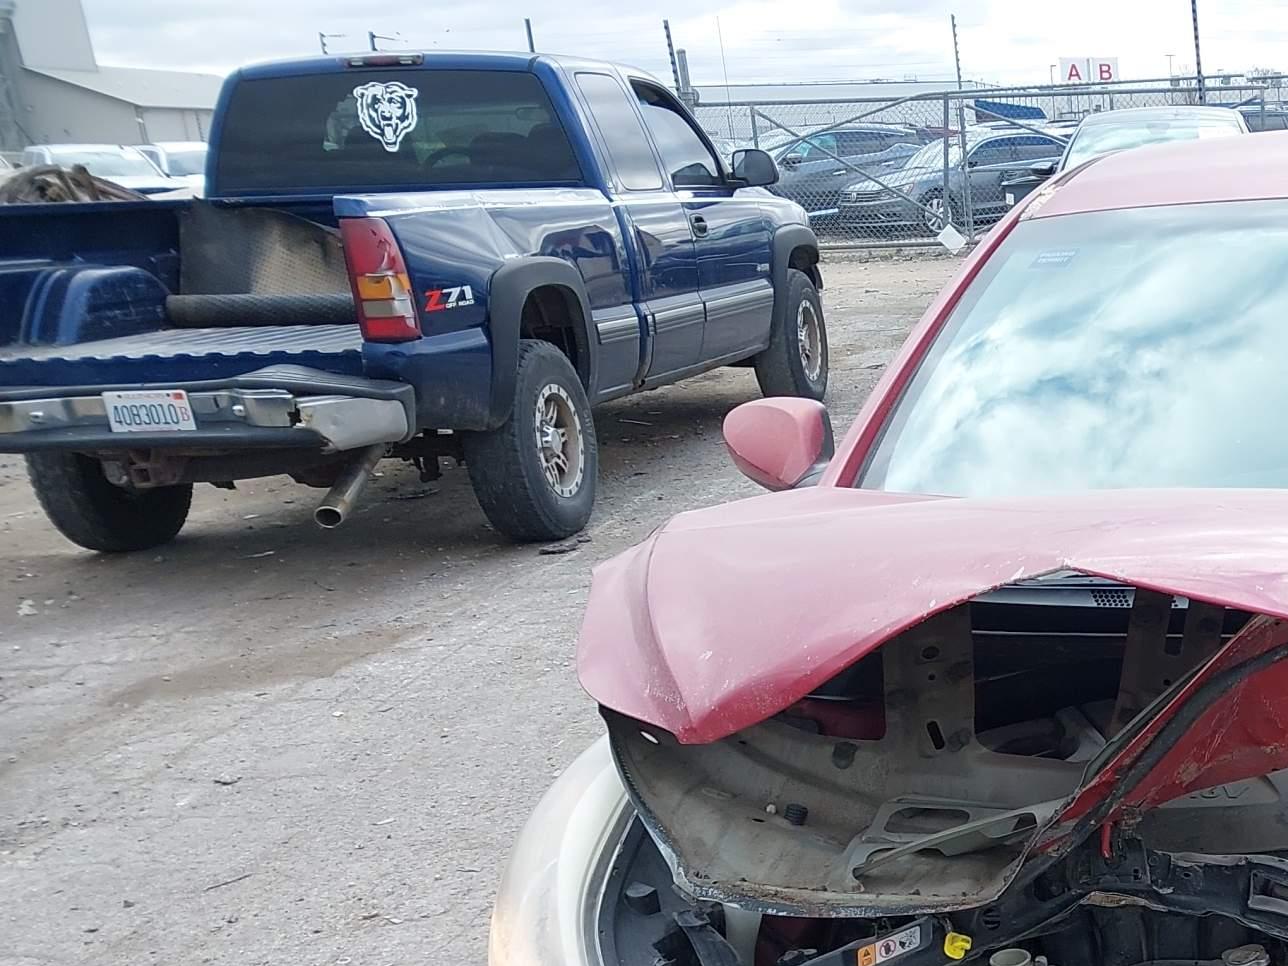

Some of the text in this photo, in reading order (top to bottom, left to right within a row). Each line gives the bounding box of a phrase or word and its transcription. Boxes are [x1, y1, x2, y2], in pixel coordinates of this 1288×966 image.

[1068, 63, 1082, 80] A
[1099, 63, 1113, 81] B
[425, 285, 473, 311] Z71
